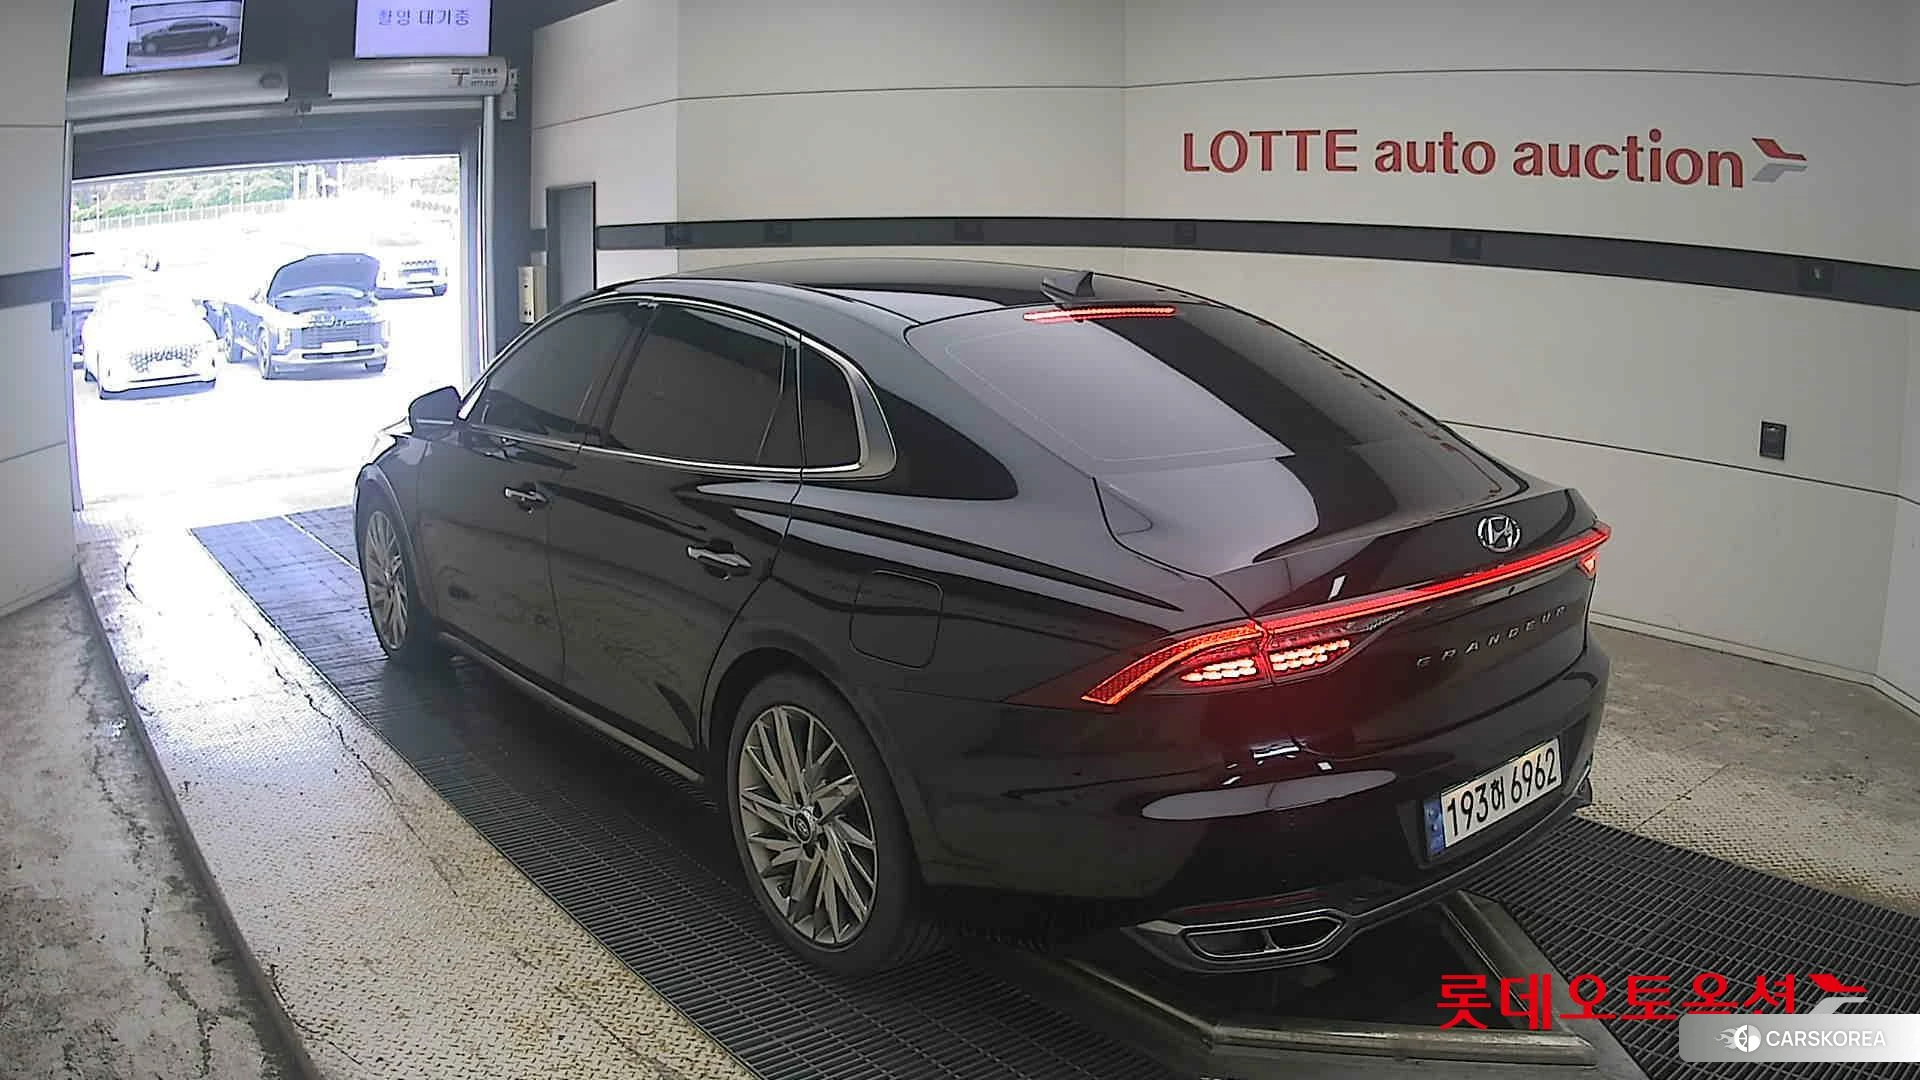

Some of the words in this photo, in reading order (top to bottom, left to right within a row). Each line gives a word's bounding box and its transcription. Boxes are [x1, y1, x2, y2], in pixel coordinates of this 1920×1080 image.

[1183, 129, 1358, 173] LOTTE
[1374, 131, 1497, 175] auto
[1512, 128, 1745, 189] auction
[1416, 604, 1567, 669] GRANDEUR
